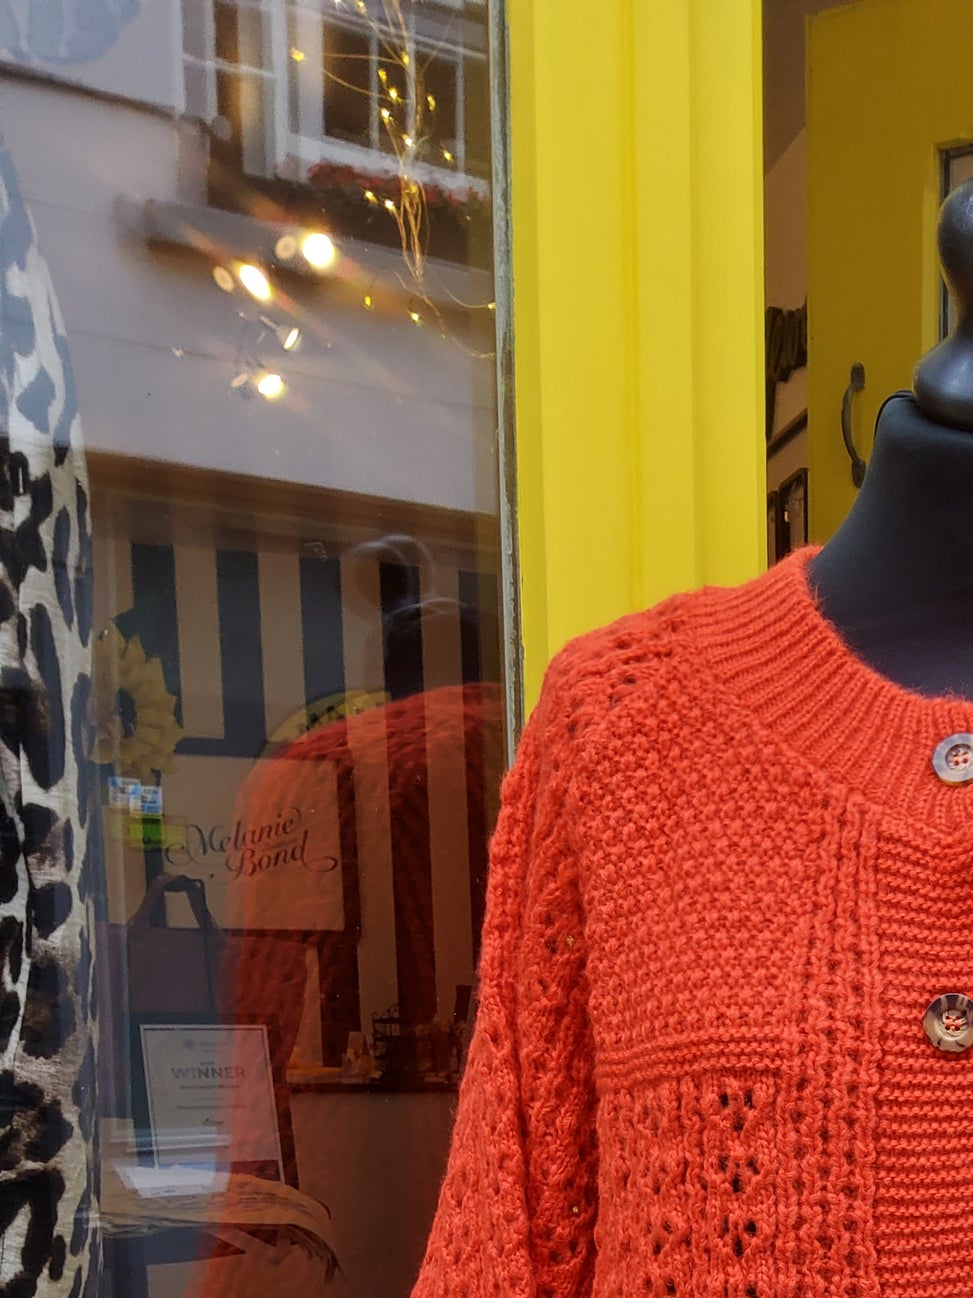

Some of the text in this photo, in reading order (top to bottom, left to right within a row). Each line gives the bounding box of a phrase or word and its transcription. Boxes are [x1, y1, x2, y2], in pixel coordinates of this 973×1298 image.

[165, 807, 301, 866] Melanie
[225, 830, 338, 880] Bond
[170, 1066, 247, 1080] WINNER
